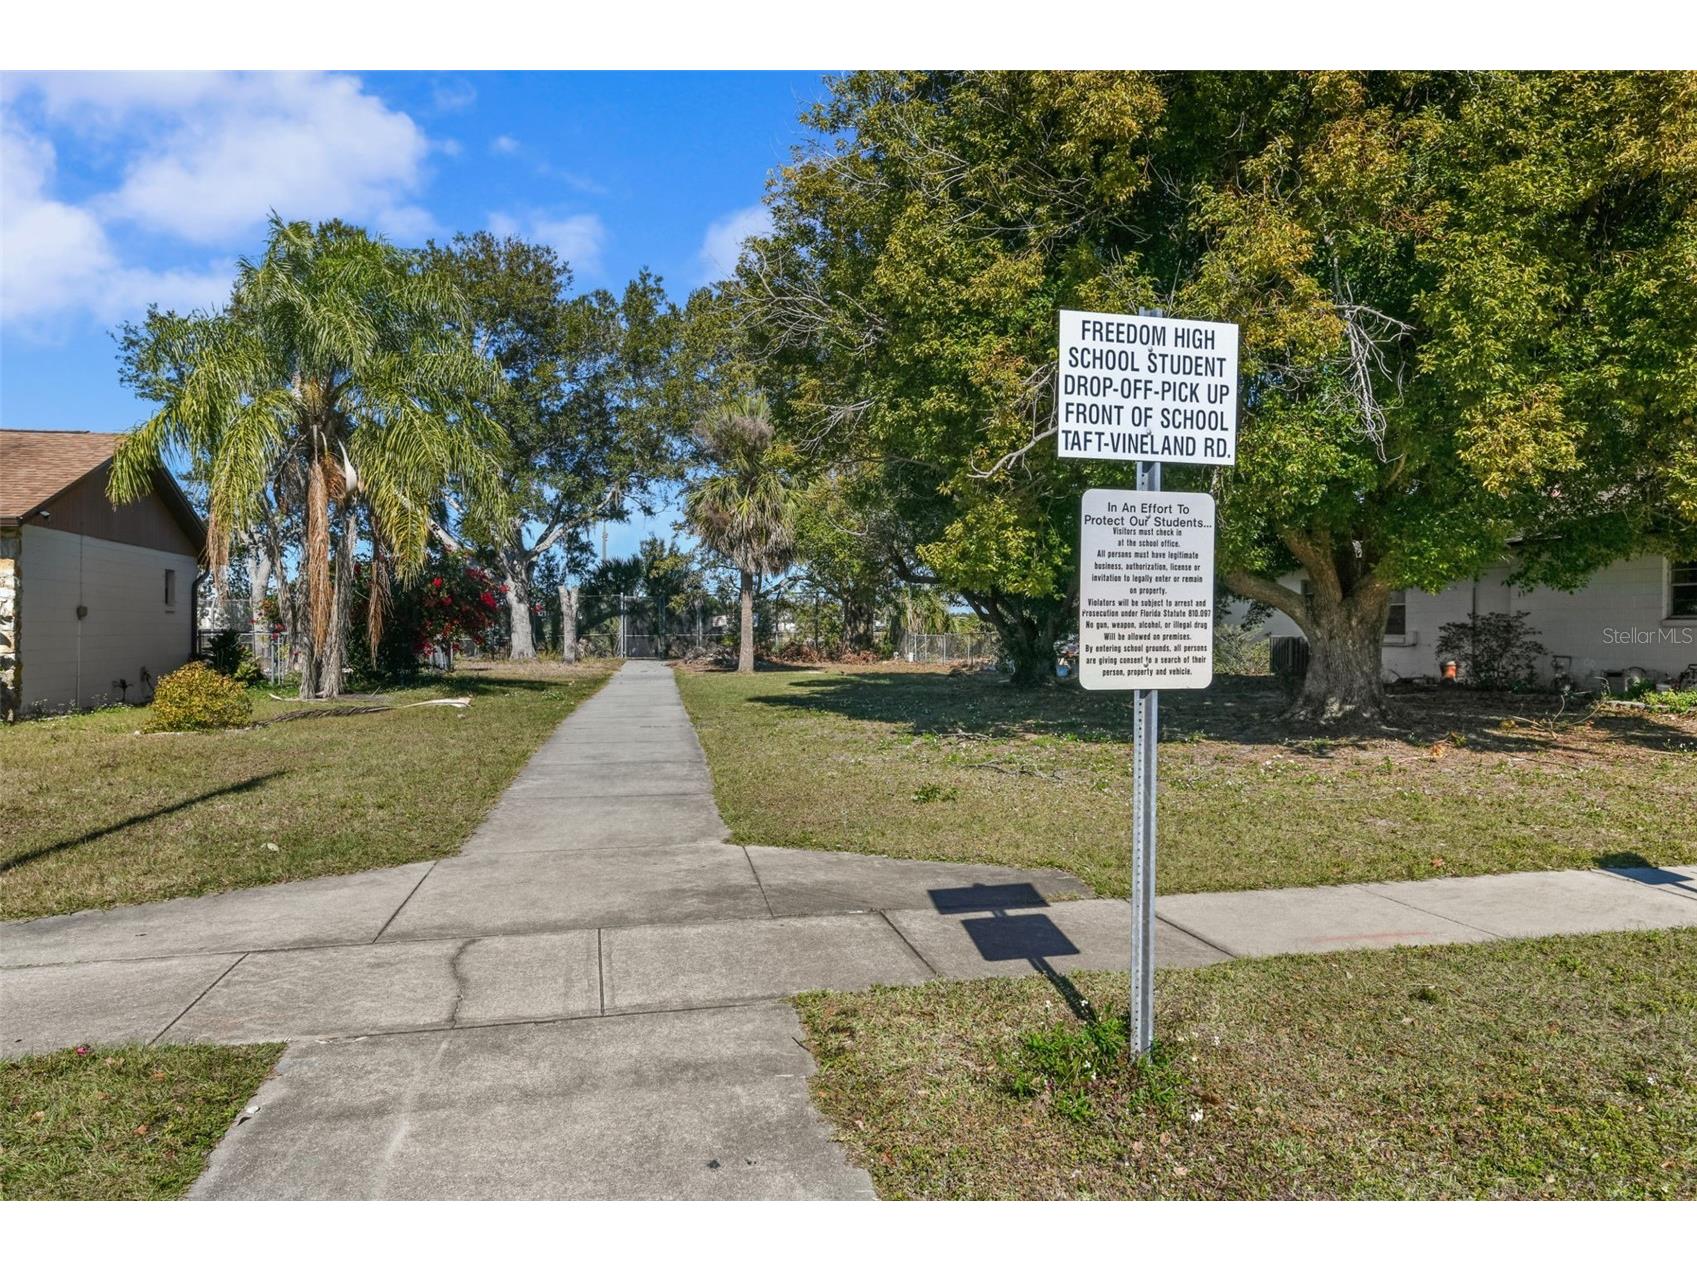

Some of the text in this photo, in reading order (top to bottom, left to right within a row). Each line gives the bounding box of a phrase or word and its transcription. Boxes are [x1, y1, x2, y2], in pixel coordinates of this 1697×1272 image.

[1082, 320, 1215, 350] FREEDOM HIGH
[1068, 347, 1226, 378] SCHOOL STUDENT
[1064, 374, 1229, 404] DROP-OFF-PICK UP
[1065, 402, 1228, 431] FRONT OF SCHOOL
[1062, 430, 1231, 458] TAFT-VINELAND RD.
[1108, 502, 1190, 514] In An Effort To
[1084, 515, 1212, 528] Protect Our Students...
[1113, 527, 1136, 535] Visitors
[1156, 528, 1174, 536] check
[1108, 551, 1132, 559] persons
[1168, 552, 1198, 560] legitimate
[1092, 574, 1121, 582] invitation
[1132, 575, 1153, 583] legally
[1139, 587, 1167, 595] property.
[1141, 599, 1163, 608] subject
[1139, 621, 1162, 629] alcohol,
[1173, 621, 1192, 629] illegal
[1163, 633, 1191, 641] premises.
[1086, 645, 1093, 653] By
[1099, 657, 1117, 665] giving
[1103, 669, 1125, 677] person,
[1127, 668, 1153, 676] property
